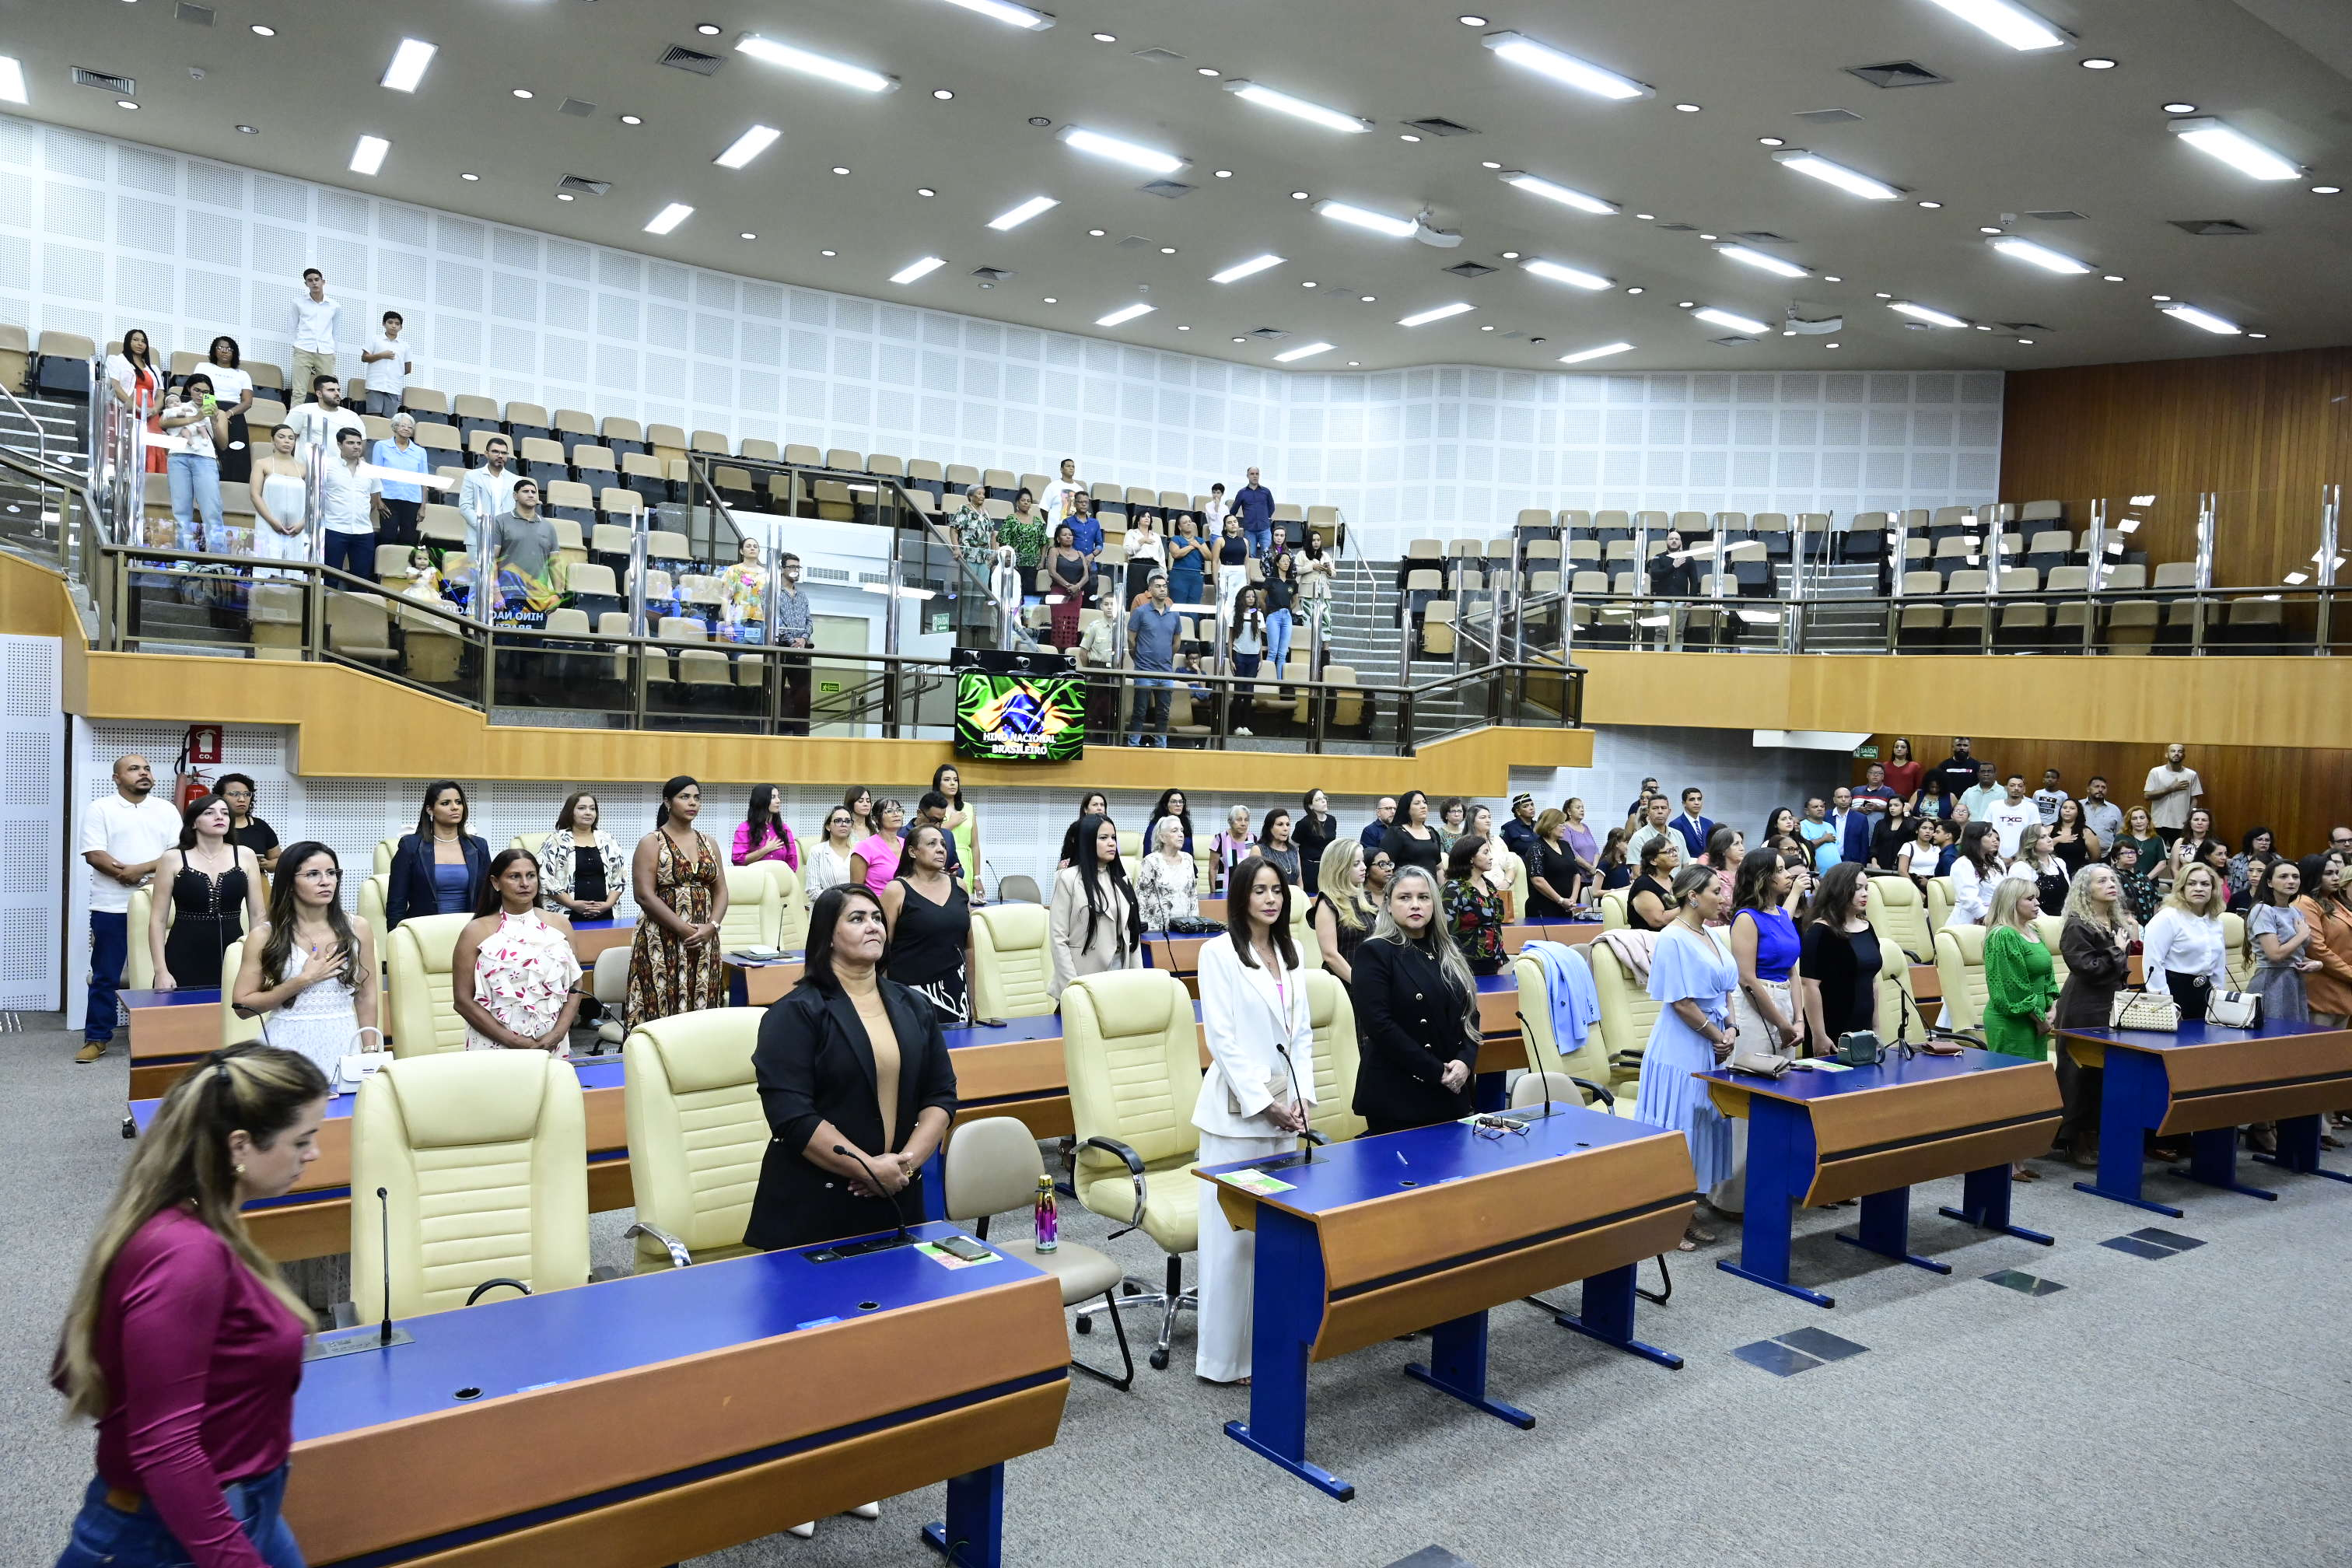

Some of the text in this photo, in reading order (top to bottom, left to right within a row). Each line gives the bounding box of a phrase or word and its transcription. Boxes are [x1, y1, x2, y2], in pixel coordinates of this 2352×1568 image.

[983, 732, 1057, 744] HINO NACIONAL
[992, 744, 1048, 755] BRASILEIRO
